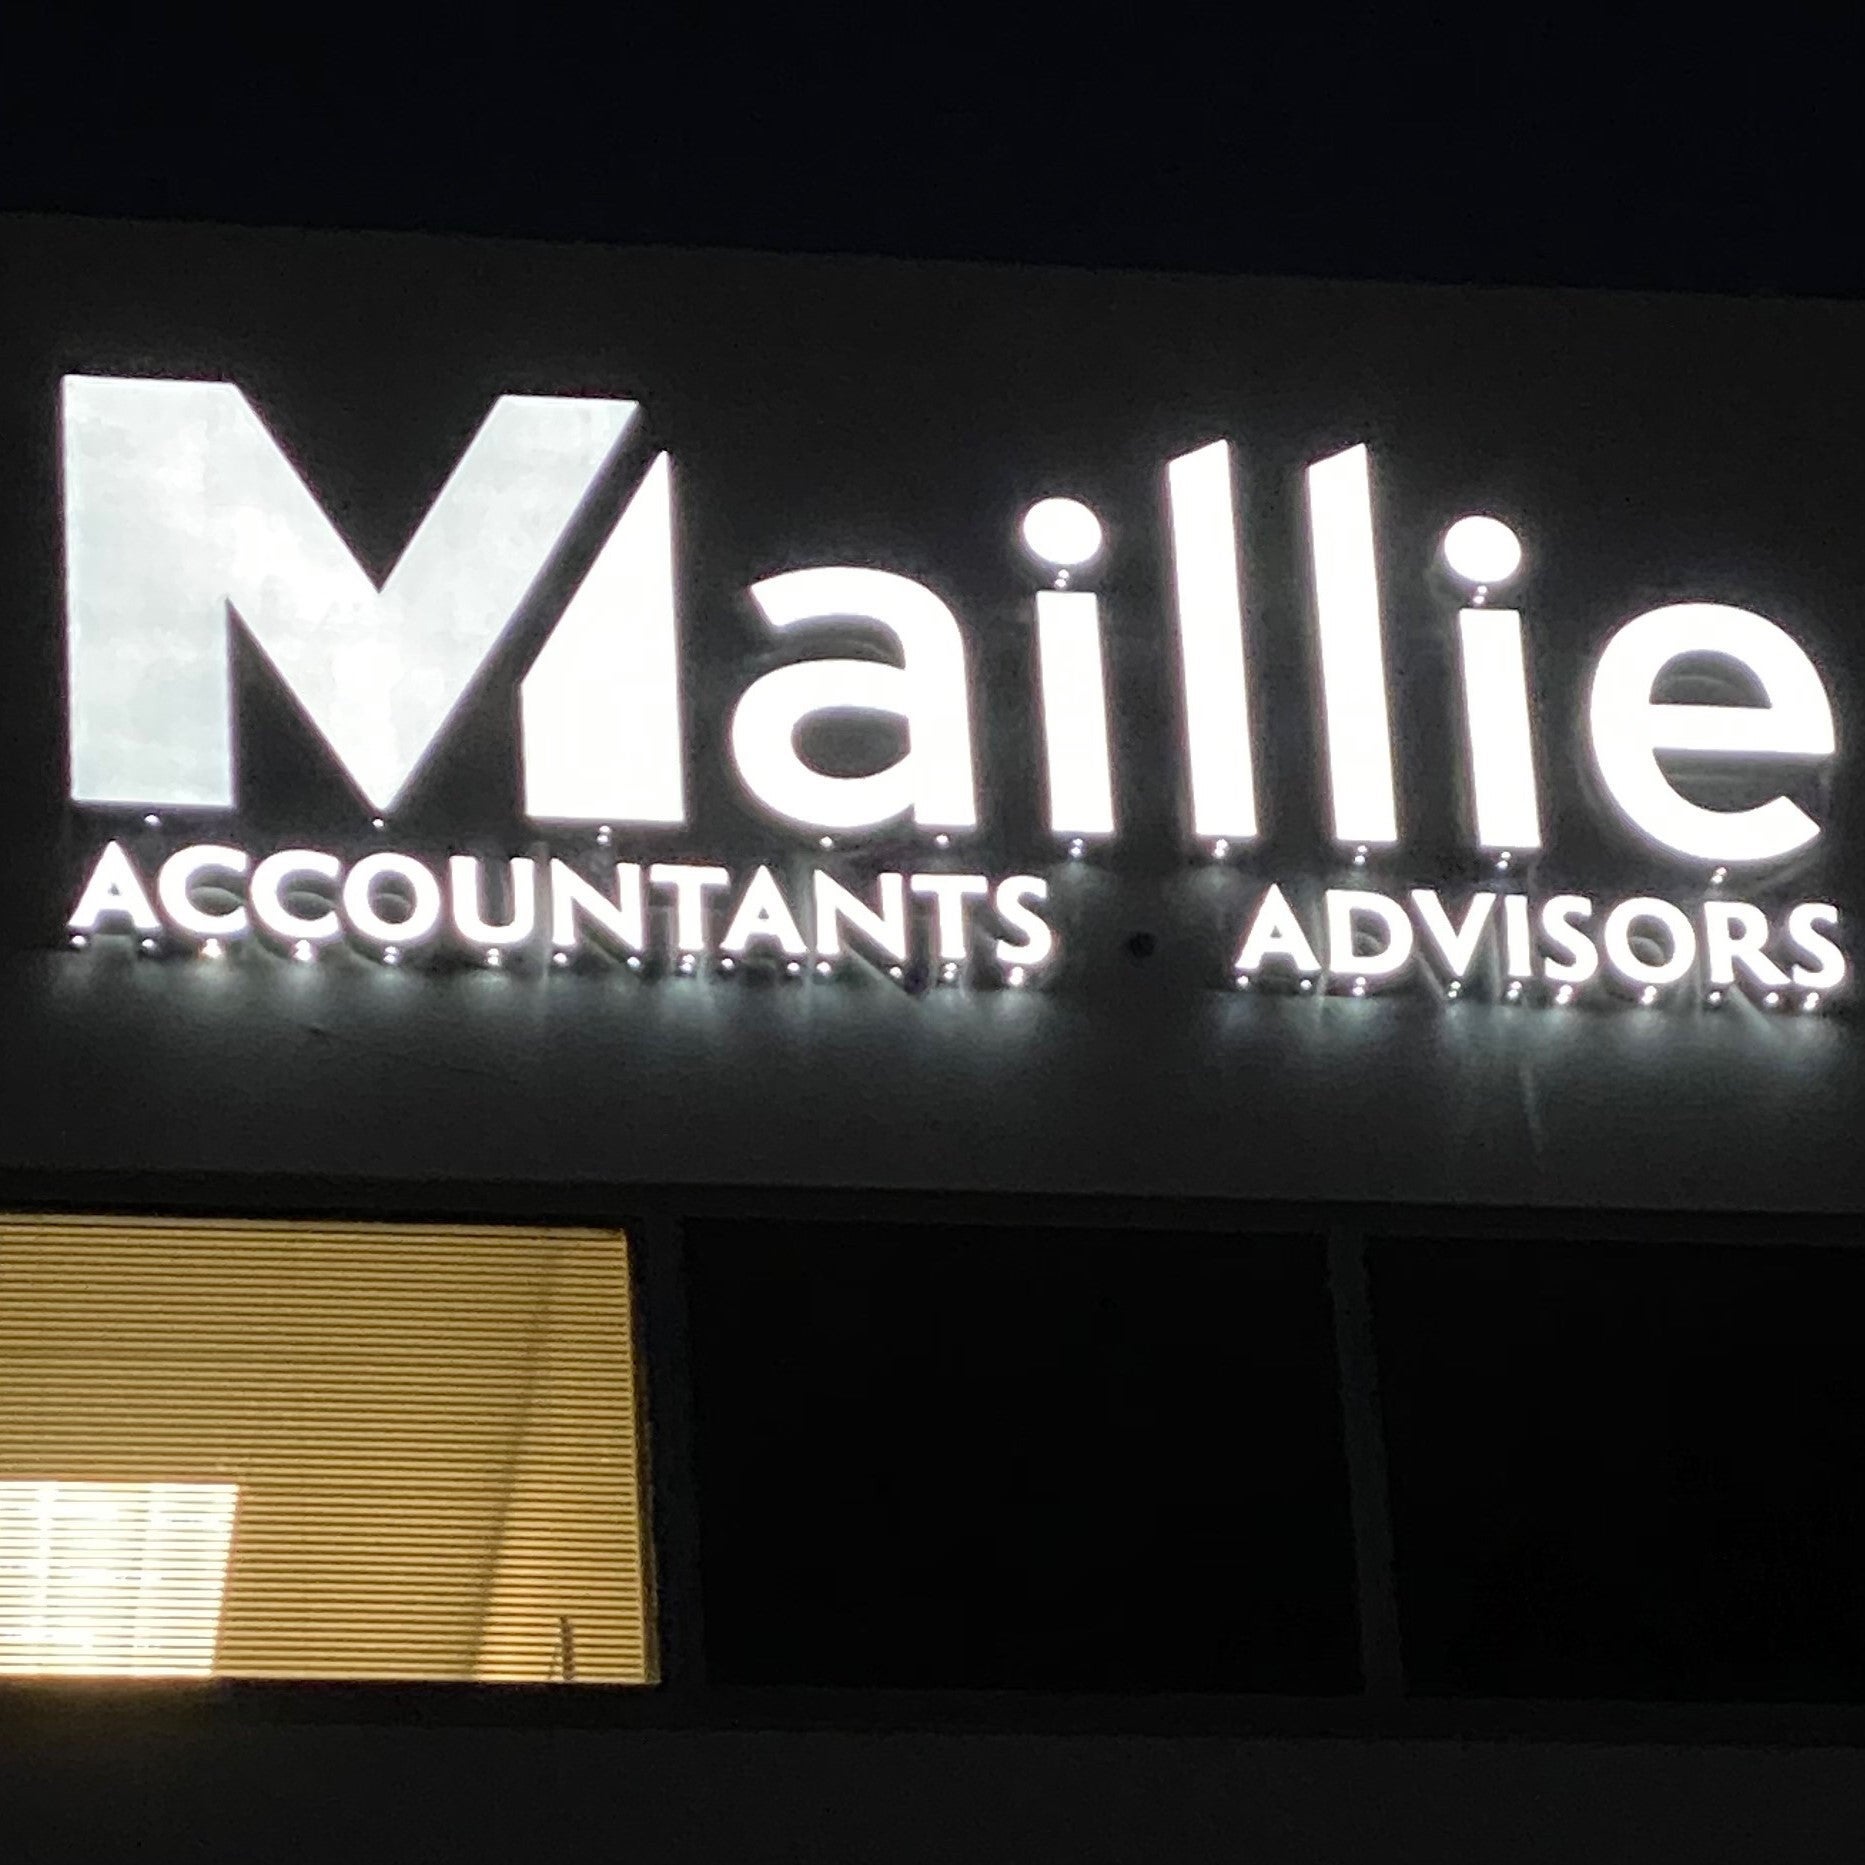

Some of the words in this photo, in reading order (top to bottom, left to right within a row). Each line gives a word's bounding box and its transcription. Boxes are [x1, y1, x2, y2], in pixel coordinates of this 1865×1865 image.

[62, 374, 1836, 863] Maillie
[68, 841, 1053, 966] ACCOUNTANTS
[1234, 883, 1847, 991] ADVISORS
